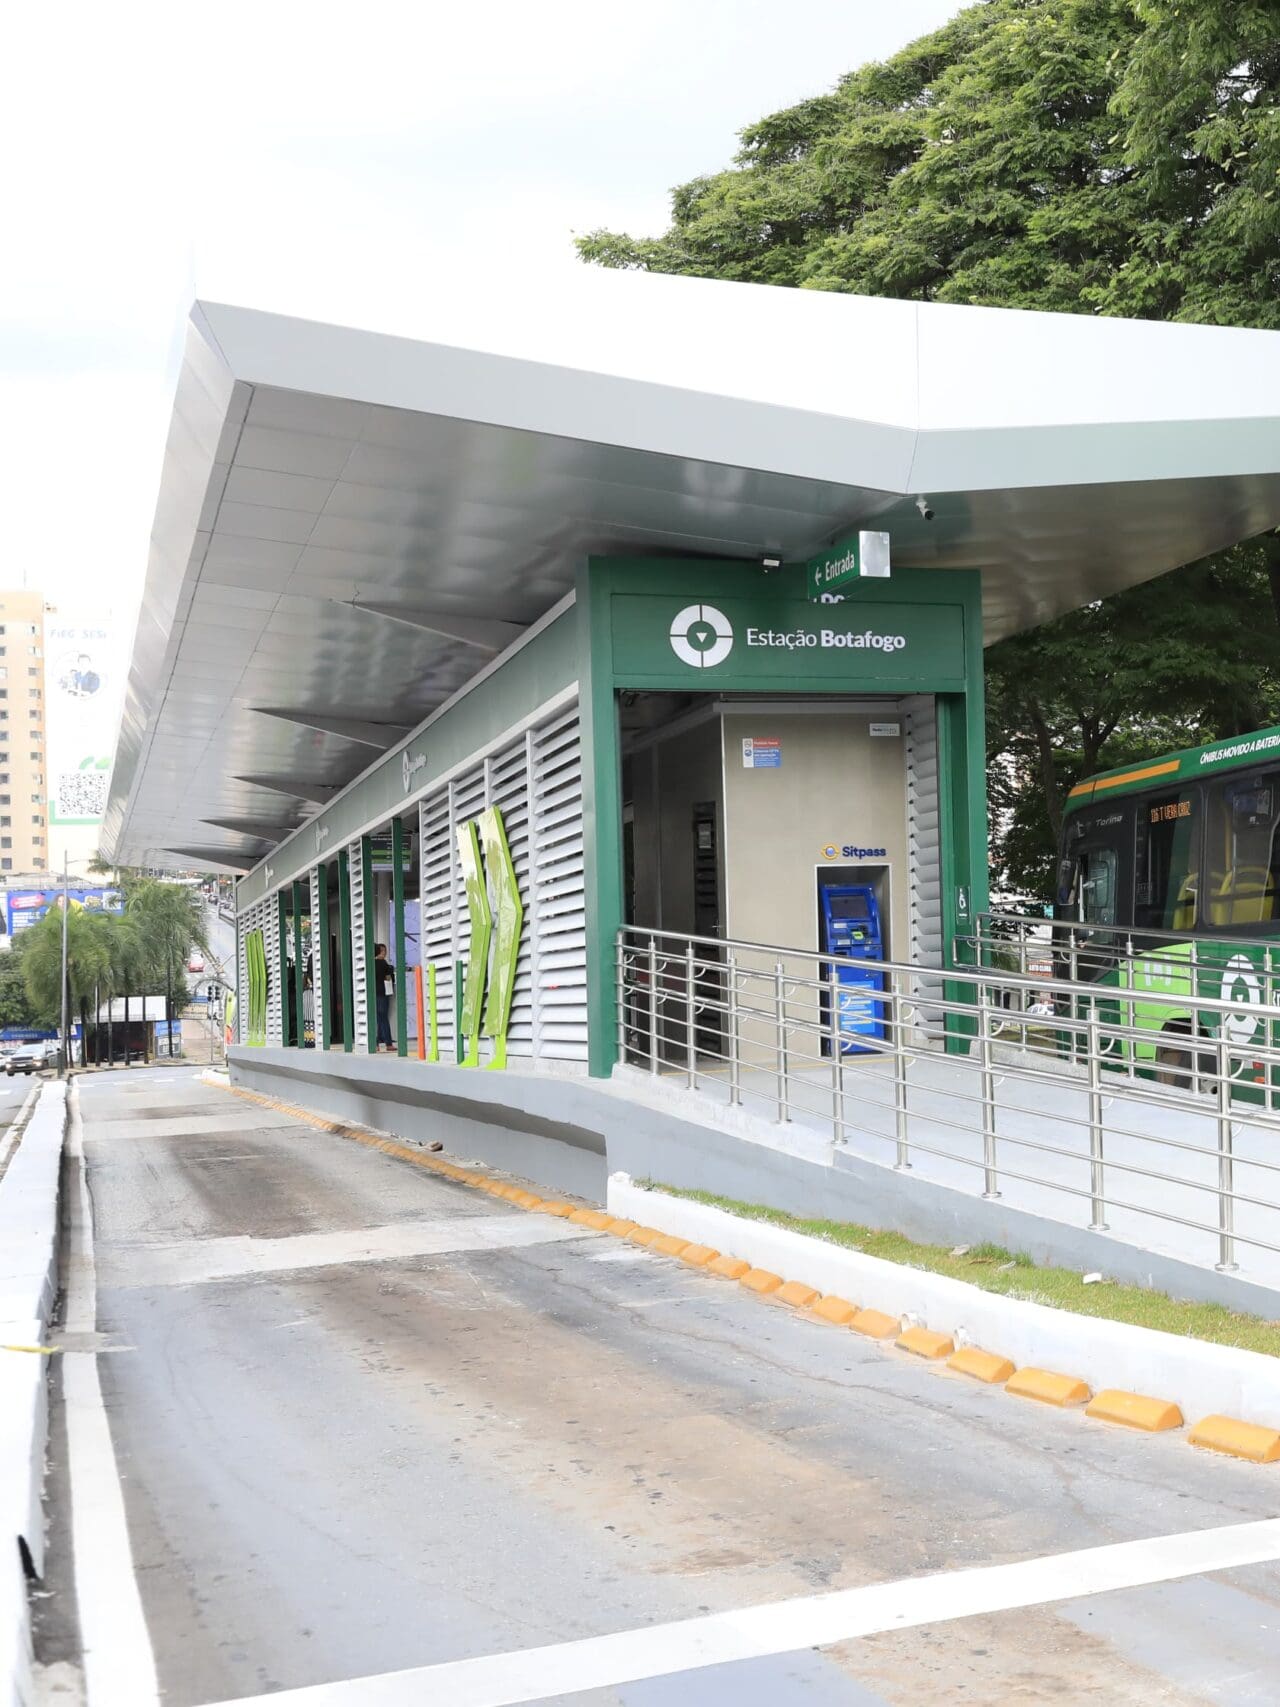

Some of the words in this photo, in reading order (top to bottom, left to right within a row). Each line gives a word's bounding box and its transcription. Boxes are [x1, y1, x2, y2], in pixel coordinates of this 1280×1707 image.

[825, 550, 855, 582] Entrada
[746, 627, 818, 651] Estação
[820, 629, 906, 653] Botafogo
[1223, 743, 1250, 759] MOVIDO
[1096, 815, 1123, 826] Torino
[842, 846, 887, 860] Sitpass
